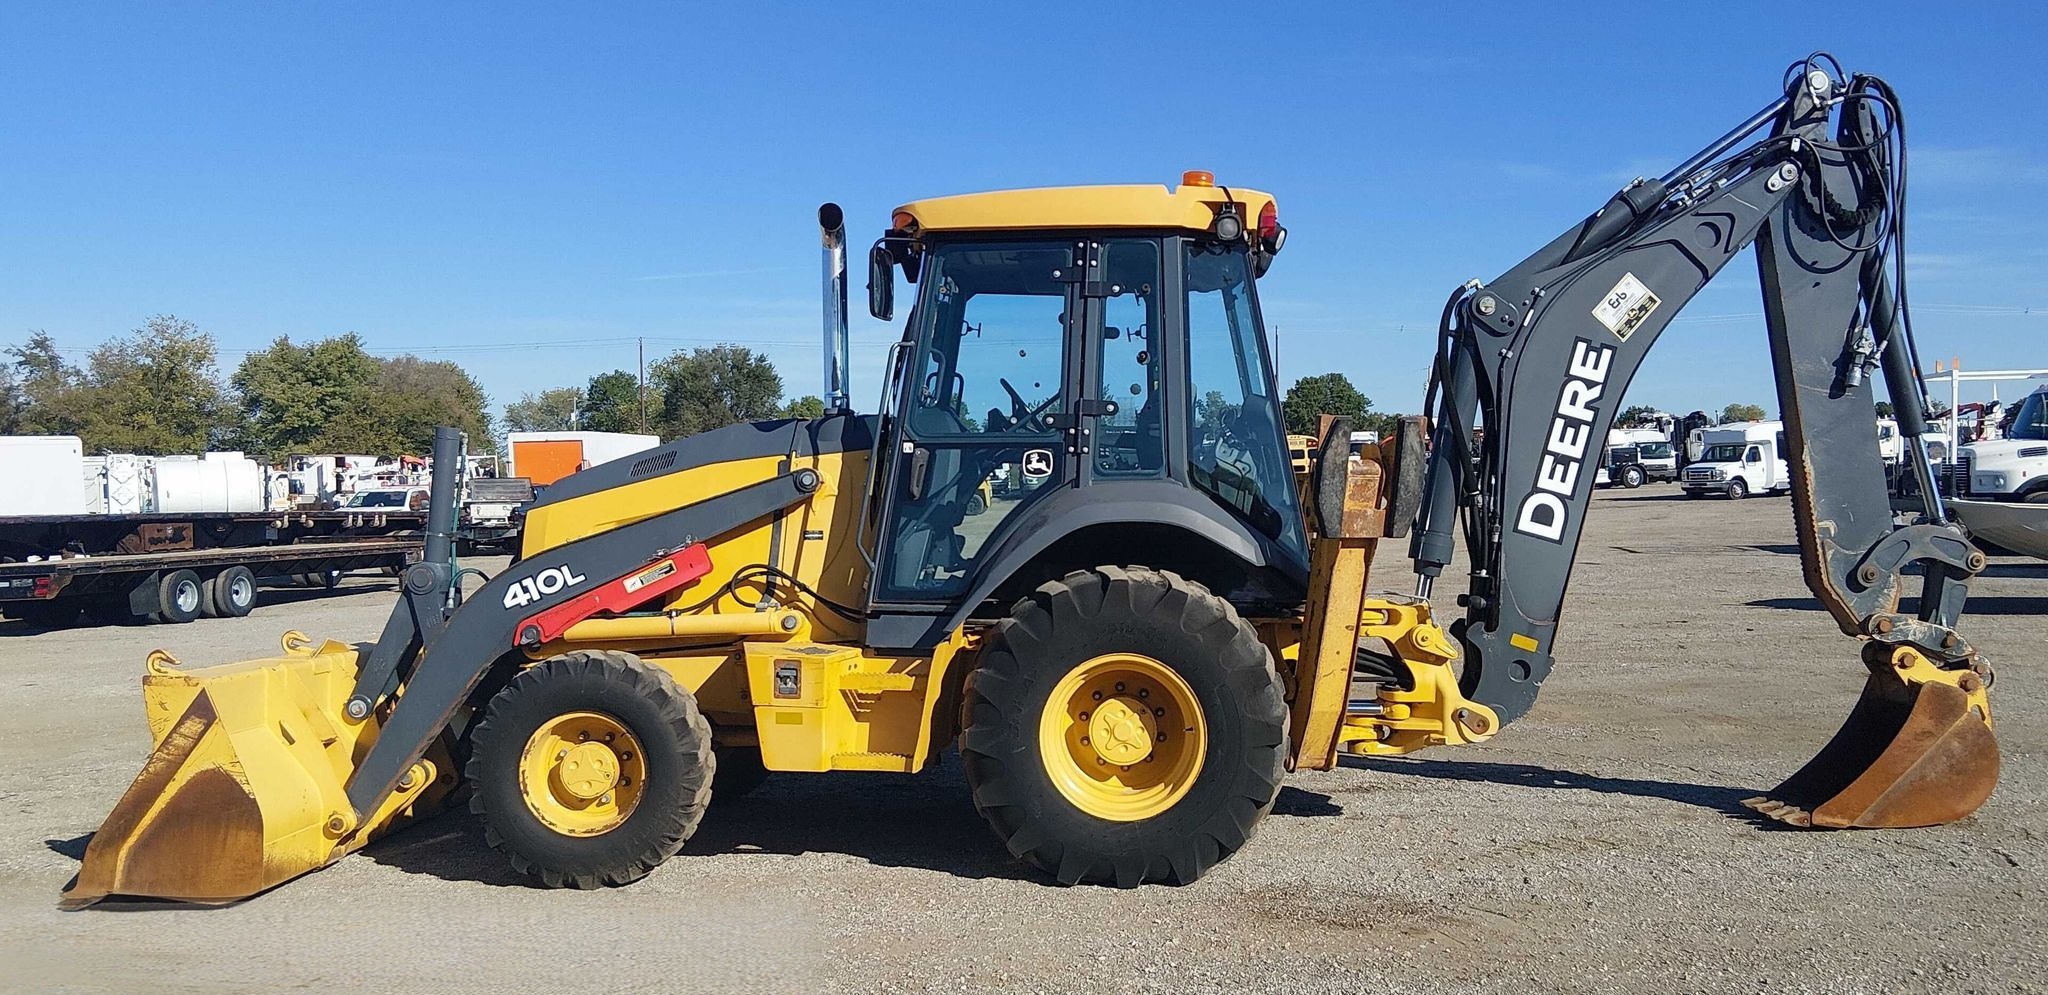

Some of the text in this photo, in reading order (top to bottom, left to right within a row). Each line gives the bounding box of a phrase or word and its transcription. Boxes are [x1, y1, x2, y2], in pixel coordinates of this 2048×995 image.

[1607, 292, 1627, 309] Erb
[1517, 341, 1613, 541] DEERE
[503, 564, 586, 609] 410L
